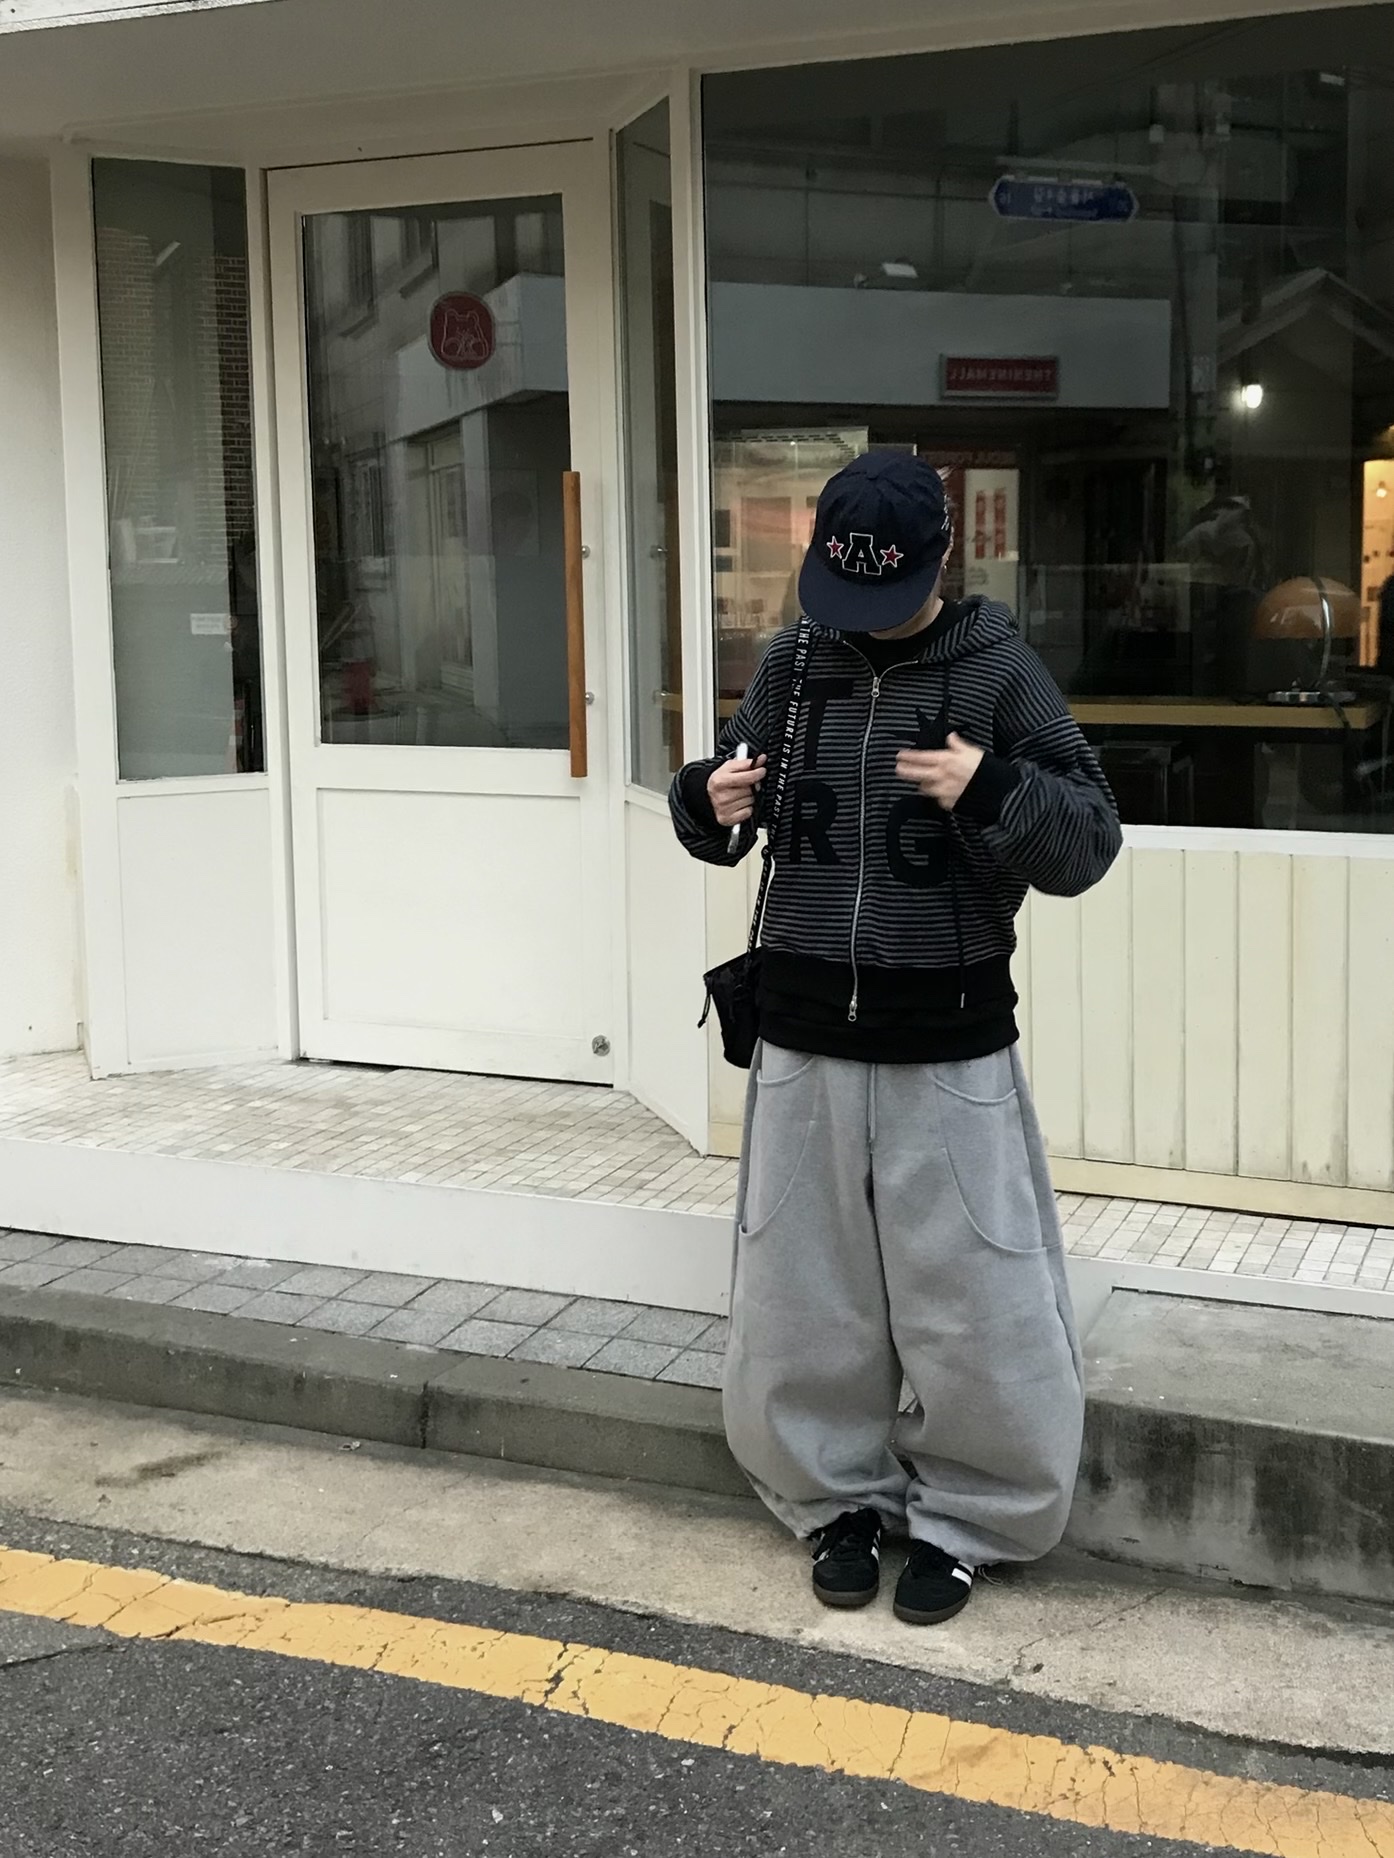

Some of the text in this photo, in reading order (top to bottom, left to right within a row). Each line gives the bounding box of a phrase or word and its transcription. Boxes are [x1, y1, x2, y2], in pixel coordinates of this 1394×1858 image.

[842, 532, 882, 576] A
[798, 628, 811, 645] THE
[785, 701, 799, 739] FUTURE
[783, 743, 791, 754] IS
[781, 758, 789, 769] IN
[777, 773, 787, 791] THE
[773, 794, 782, 818] PAST
[789, 781, 950, 887] R G
